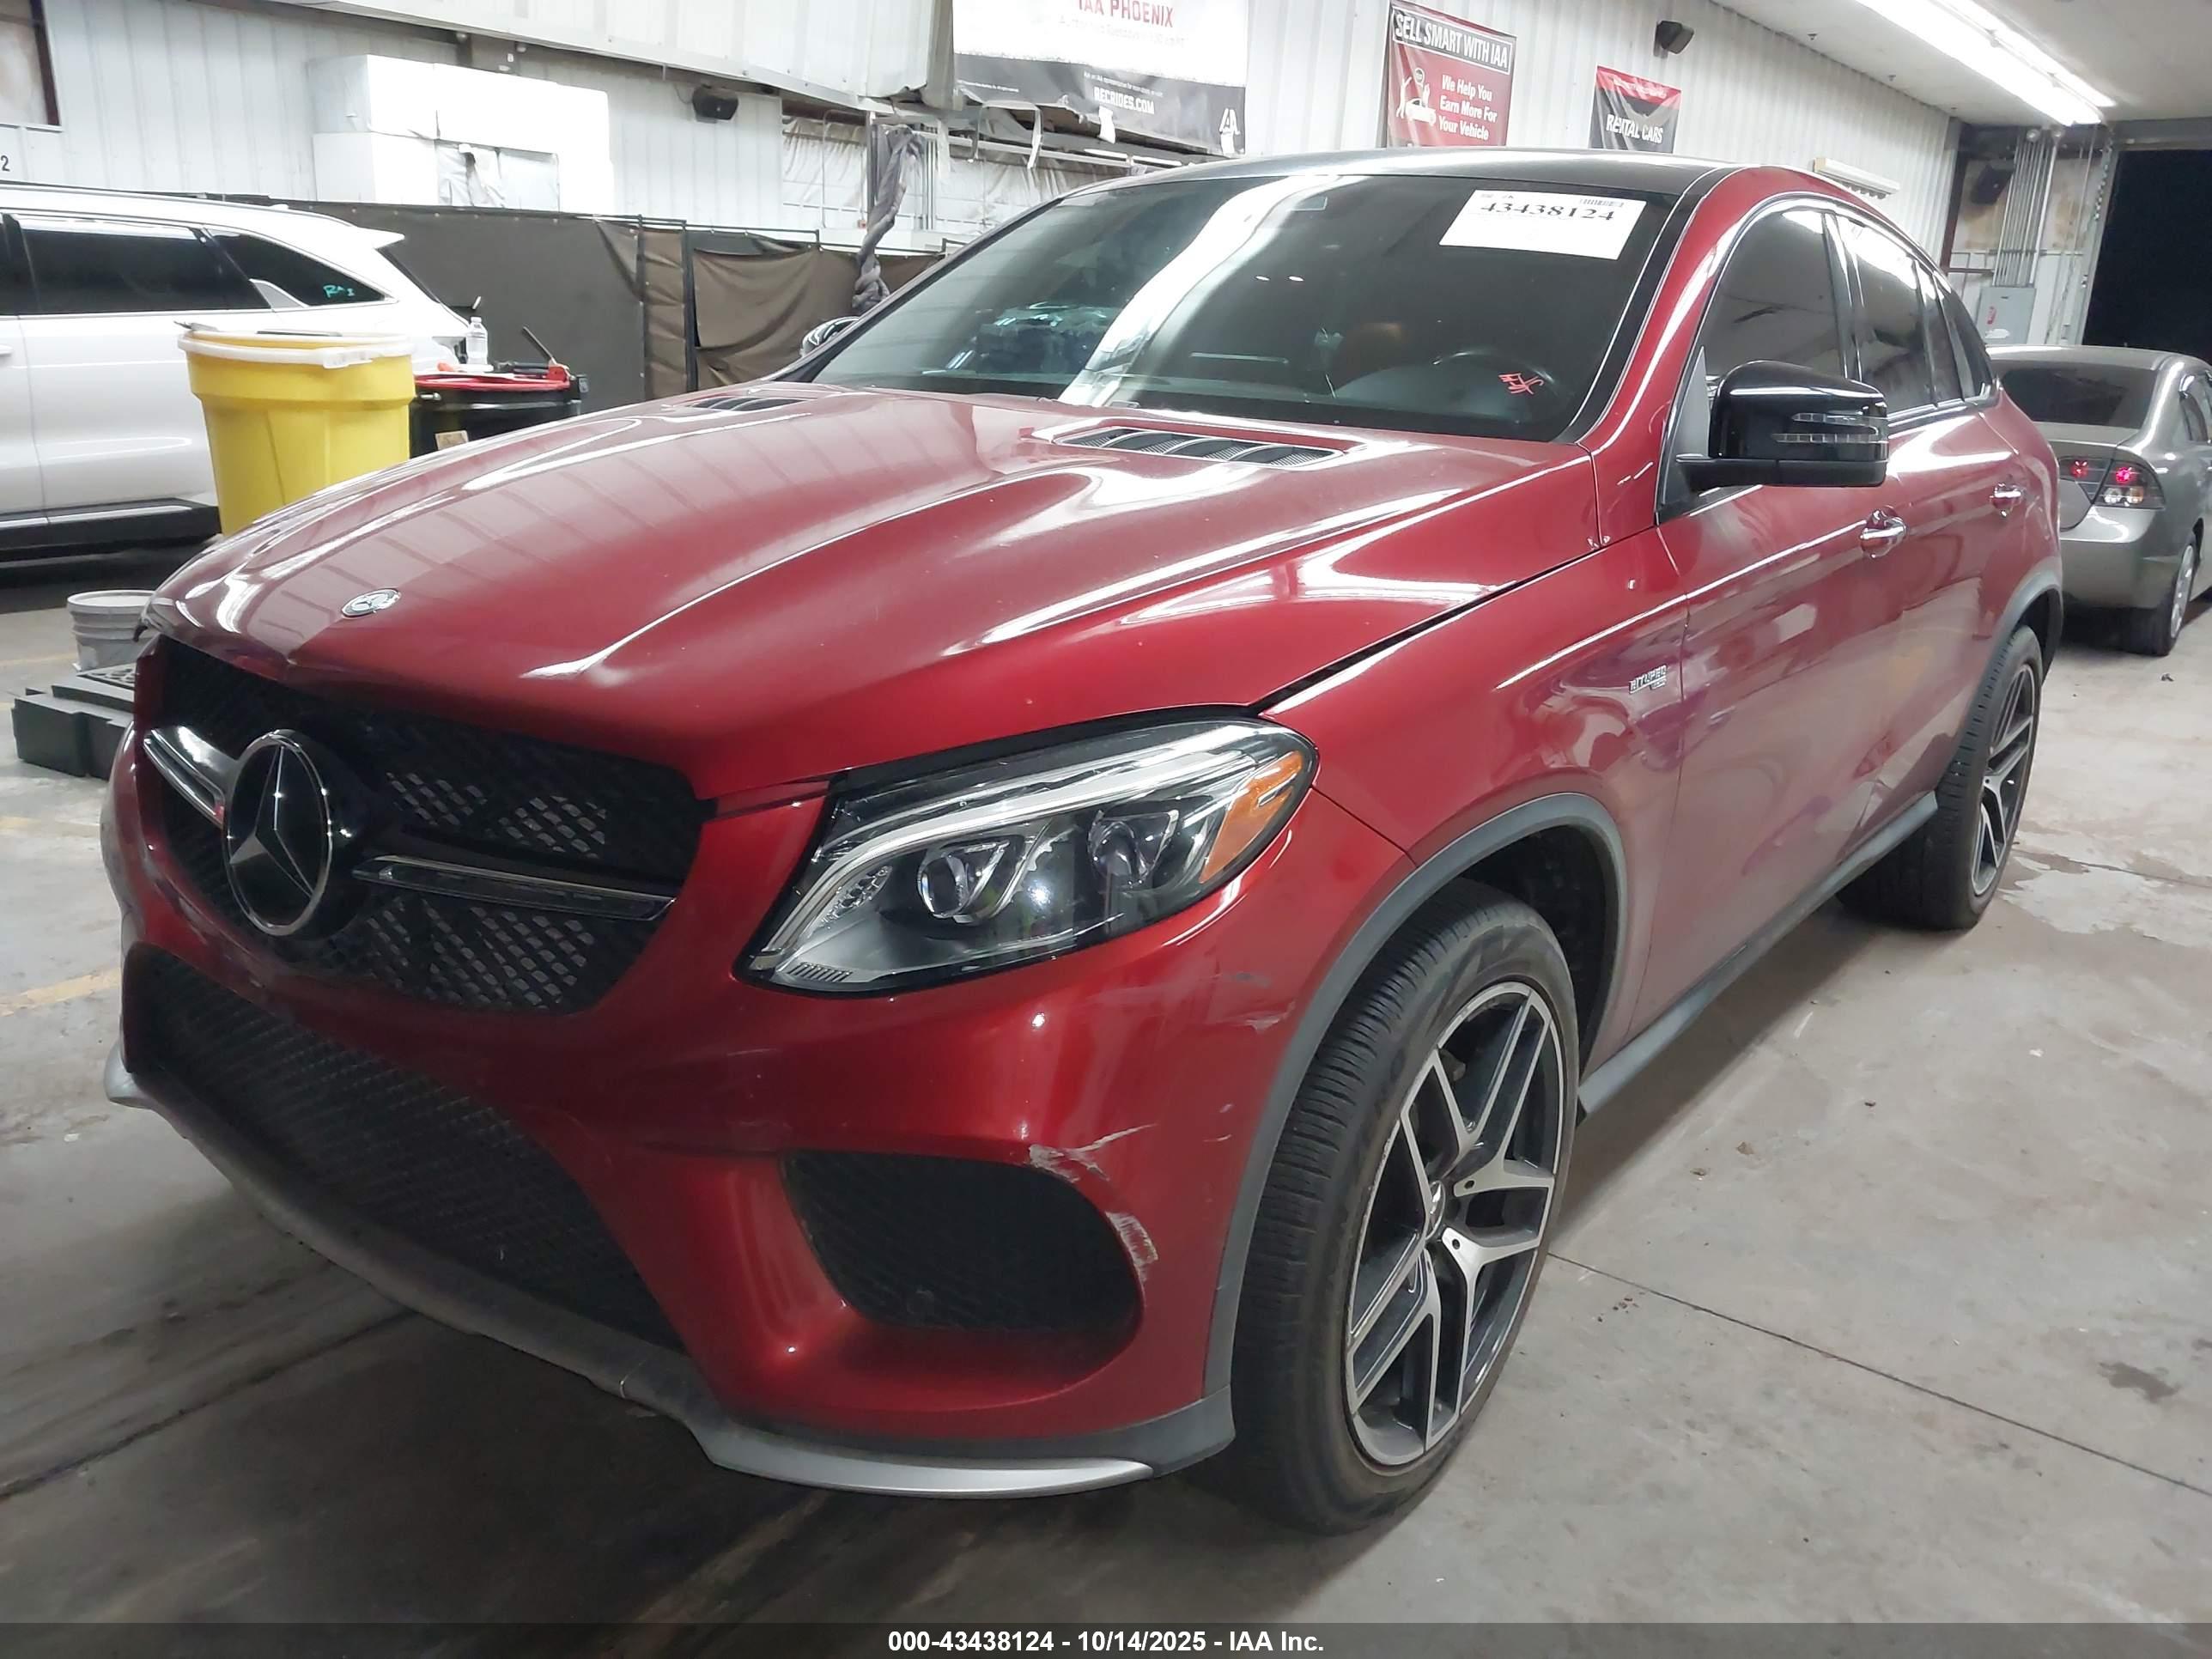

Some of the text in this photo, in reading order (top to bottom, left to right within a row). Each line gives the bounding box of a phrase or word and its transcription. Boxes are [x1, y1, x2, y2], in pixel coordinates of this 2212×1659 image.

[1110, 0, 1174, 27] PHOENIX
[1395, 14, 1509, 69] SELL SMART WITH IAA
[1441, 74, 1493, 102] We Help You
[1439, 94, 1498, 123] Earn More For
[1438, 115, 1490, 141] Your Vehicle
[1606, 113, 1664, 144] RENTAL CARS
[1480, 202, 1615, 221] 43438124
